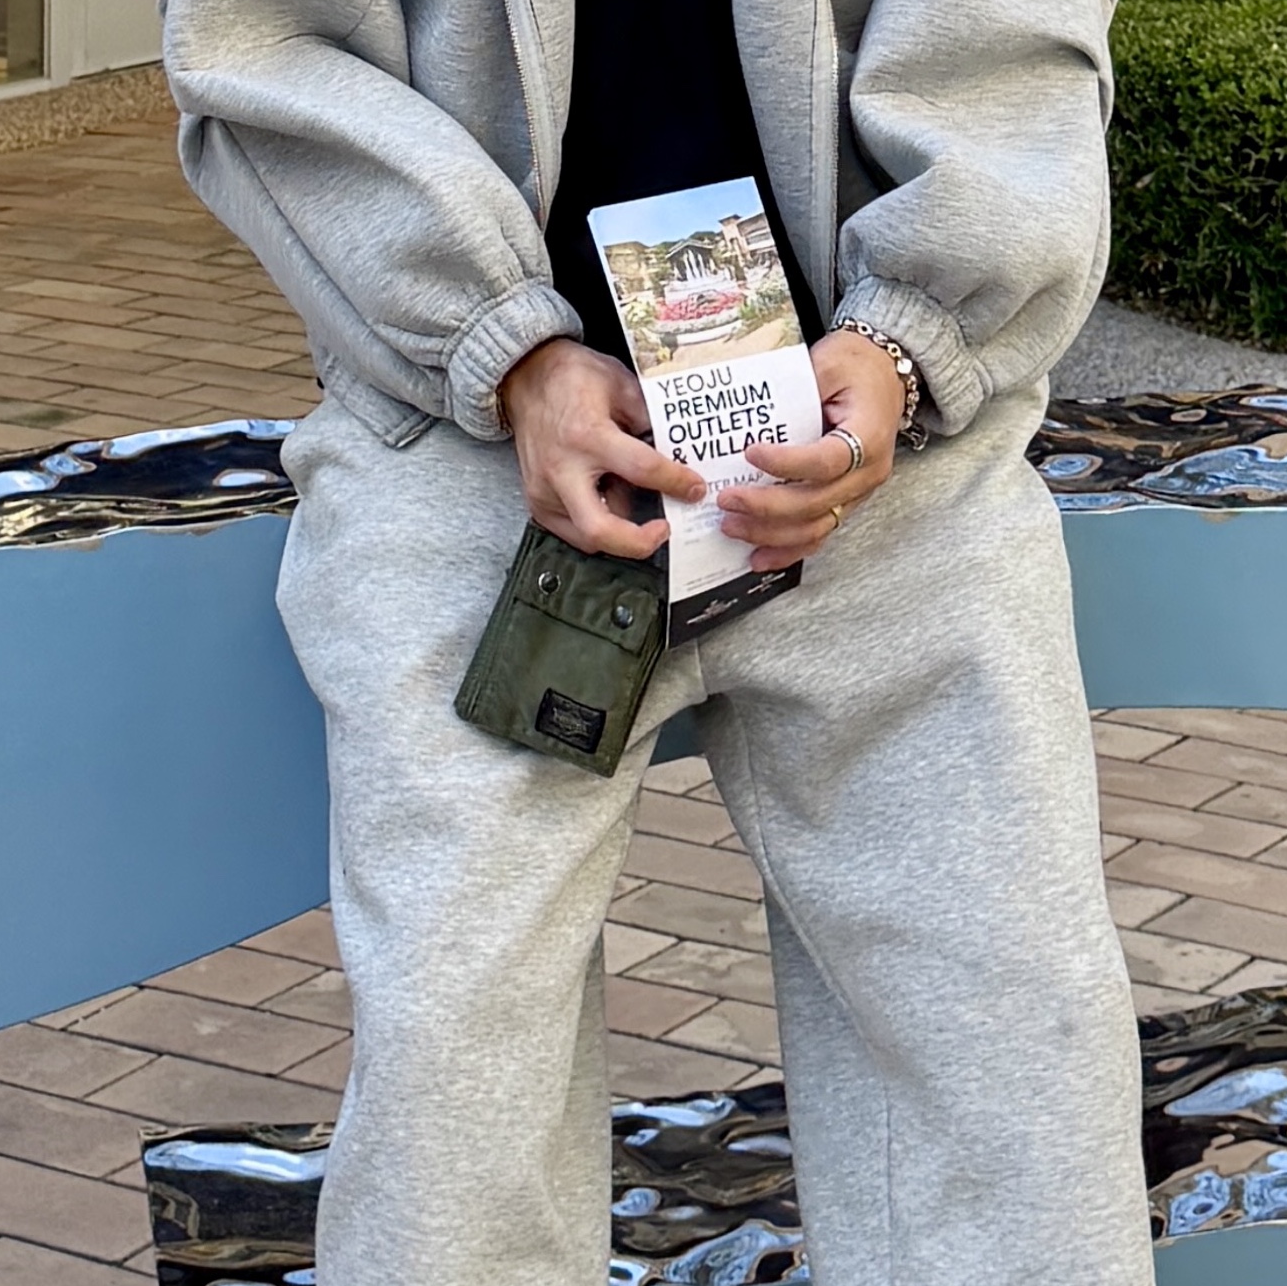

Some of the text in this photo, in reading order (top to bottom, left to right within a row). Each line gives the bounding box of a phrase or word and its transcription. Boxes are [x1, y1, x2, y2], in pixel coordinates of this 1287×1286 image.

[657, 366, 732, 399] YEOJU
[663, 380, 771, 422] PREMIUM
[672, 424, 789, 465] & VILLAGE
